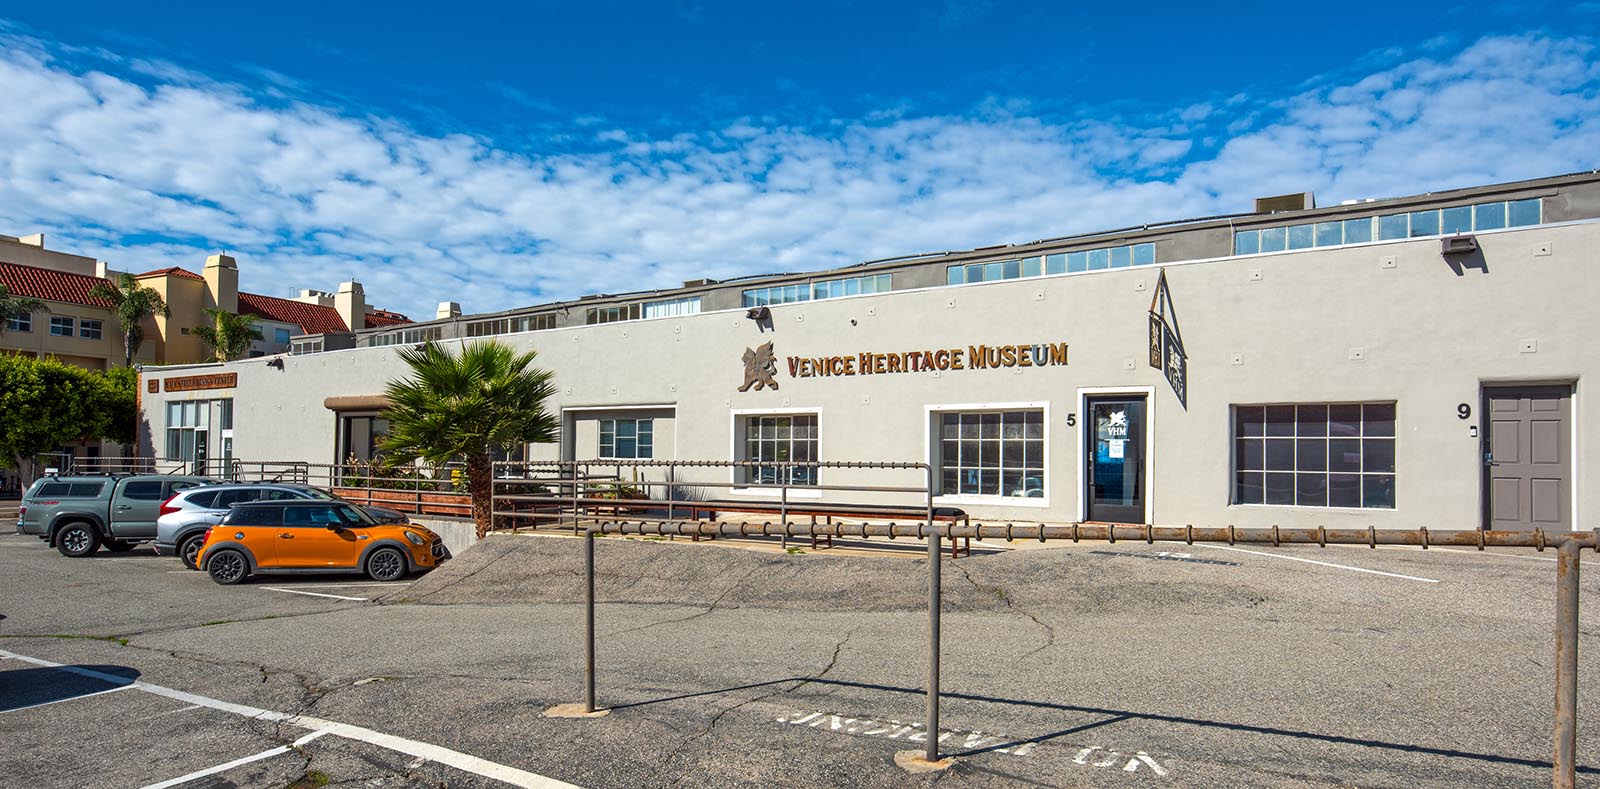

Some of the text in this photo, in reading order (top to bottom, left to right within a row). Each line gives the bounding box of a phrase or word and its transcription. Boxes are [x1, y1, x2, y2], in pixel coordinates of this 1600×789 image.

[787, 342, 1069, 378] VENICE HERITAGE MUSEUM
[1457, 403, 1471, 420] 9
[1066, 413, 1076, 427] 5
[1107, 427, 1126, 436] VHM
